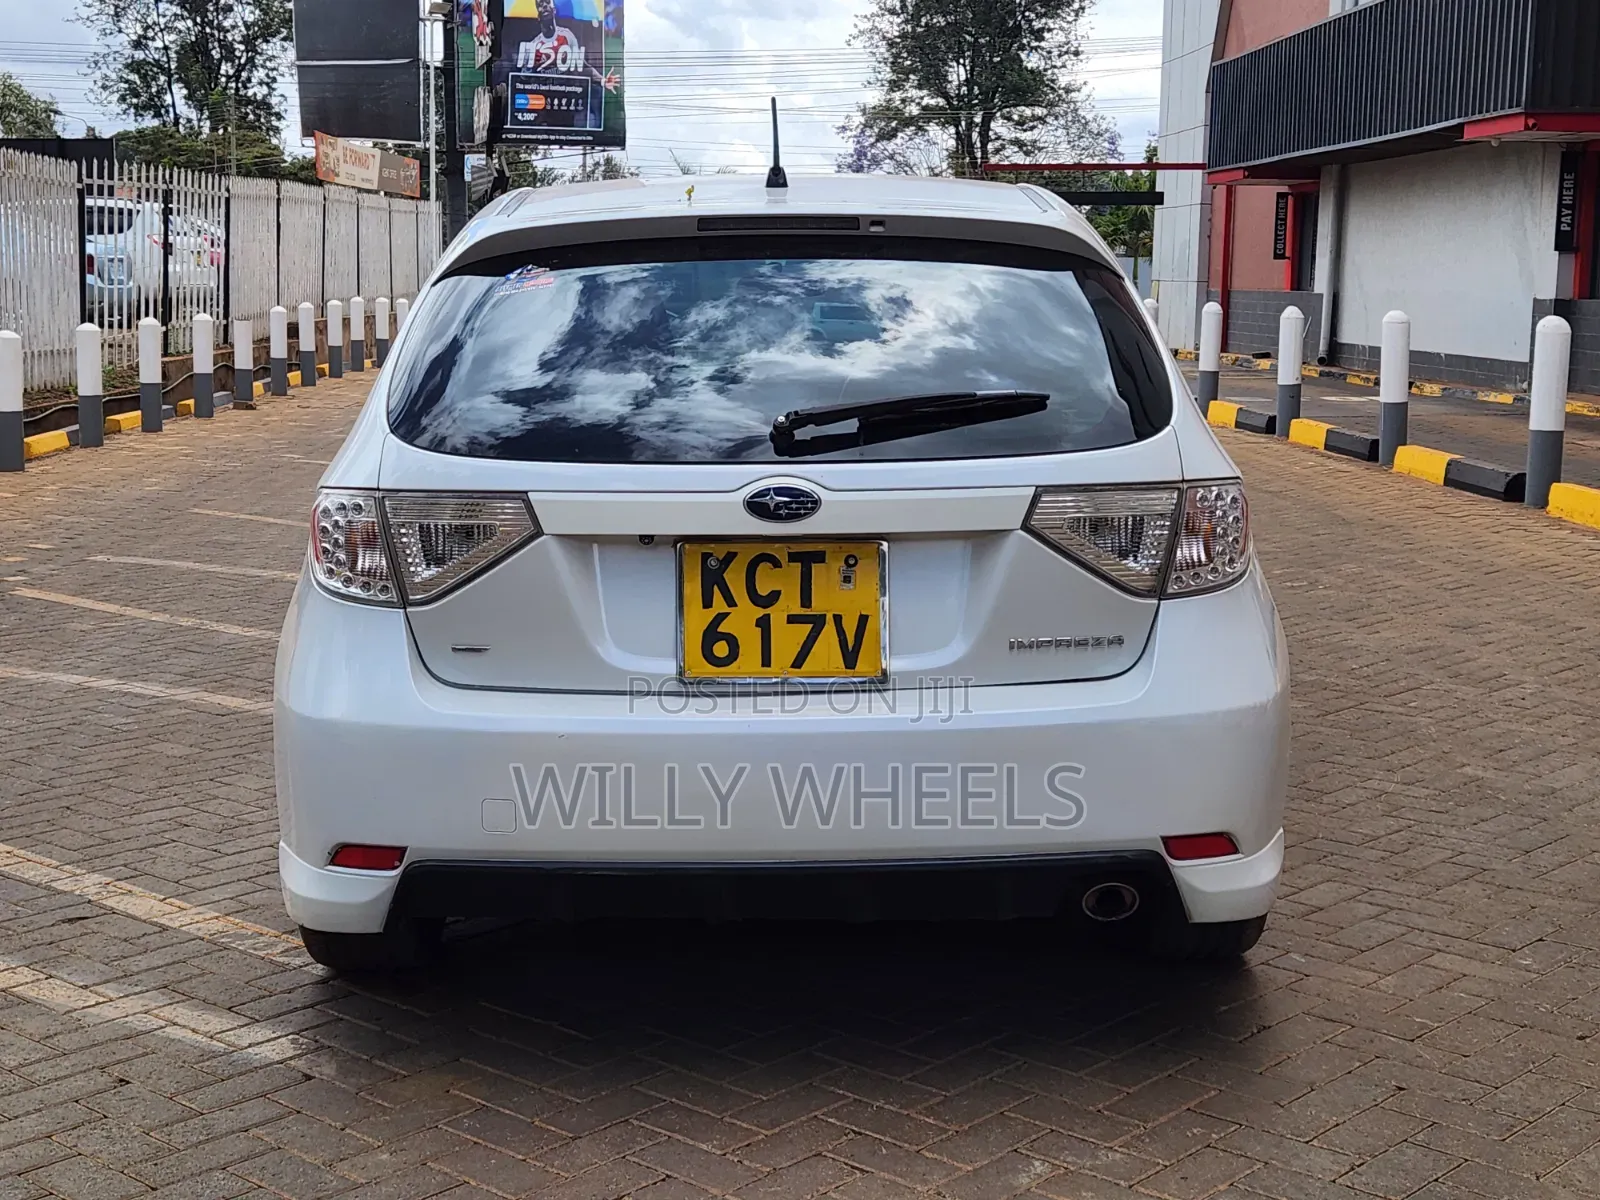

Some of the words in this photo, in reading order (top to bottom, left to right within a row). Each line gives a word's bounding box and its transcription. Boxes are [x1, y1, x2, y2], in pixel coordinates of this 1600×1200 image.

[556, 45, 585, 72] ON
[1562, 172, 1575, 204] HERE
[1278, 197, 1287, 219] HERE
[1560, 208, 1573, 231] PAY
[1276, 220, 1286, 254] COLLECT
[701, 551, 826, 609] KCT
[701, 612, 869, 670] 617V
[1008, 634, 1125, 651] IMPREZA
